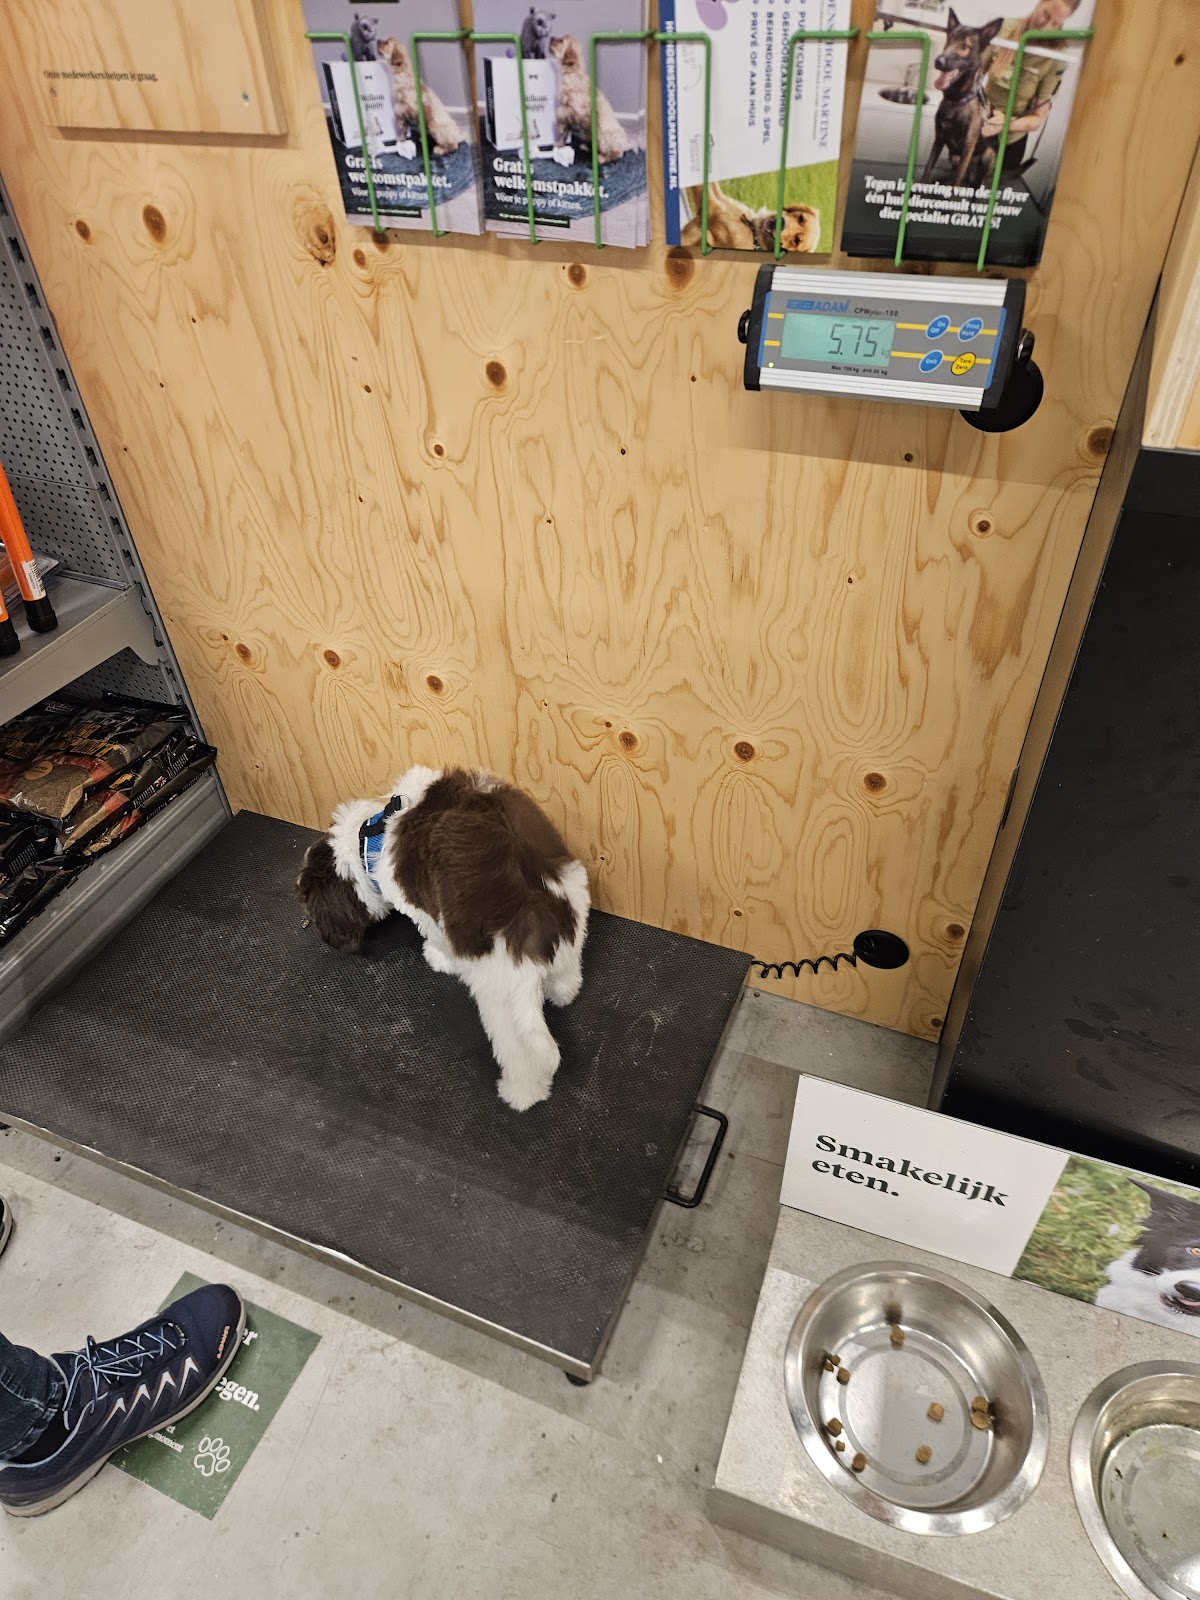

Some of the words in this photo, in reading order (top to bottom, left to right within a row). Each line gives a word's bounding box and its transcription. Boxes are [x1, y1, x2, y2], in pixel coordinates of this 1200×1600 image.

[749, 11, 760, 47] PRIVÉ
[749, 51, 758, 67] OF
[764, 11, 775, 102] BEHENDIGHEID
[794, 11, 806, 100] PUPYCURSUS
[61, 69, 105, 80] medewerkers
[105, 71, 129, 82] helpen
[748, 70, 757, 96] AAN
[665, 20, 679, 190] HNDENSCHOOLMARTINE.NL
[748, 99, 757, 127] HUIS
[818, 87, 832, 148] MARTINE
[762, 117, 771, 144] SPEL
[345, 154, 384, 170] Grais
[493, 174, 610, 199] welkmstpakkt.
[864, 175, 896, 193] Tegen
[896, 178, 953, 199] inevering
[953, 186, 975, 198] van
[975, 184, 1002, 200] dee
[1002, 187, 1030, 204] flyer
[522, 195, 547, 209] pppy
[547, 198, 557, 208] of
[865, 190, 885, 205] één
[886, 191, 970, 212] huidierconsult
[970, 202, 990, 214] van
[993, 202, 1023, 217] jouw
[879, 205, 950, 225] dierpecialist
[950, 213, 1002, 230] GRATS!
[812, 301, 848, 313] ADAM
[828, 323, 881, 358] 5.75
[925, 357, 938, 365] Unit
[811, 1159, 899, 1197] eten.
[815, 1134, 1009, 1207] Smakelijk
[214, 1376, 260, 1412] egen.
